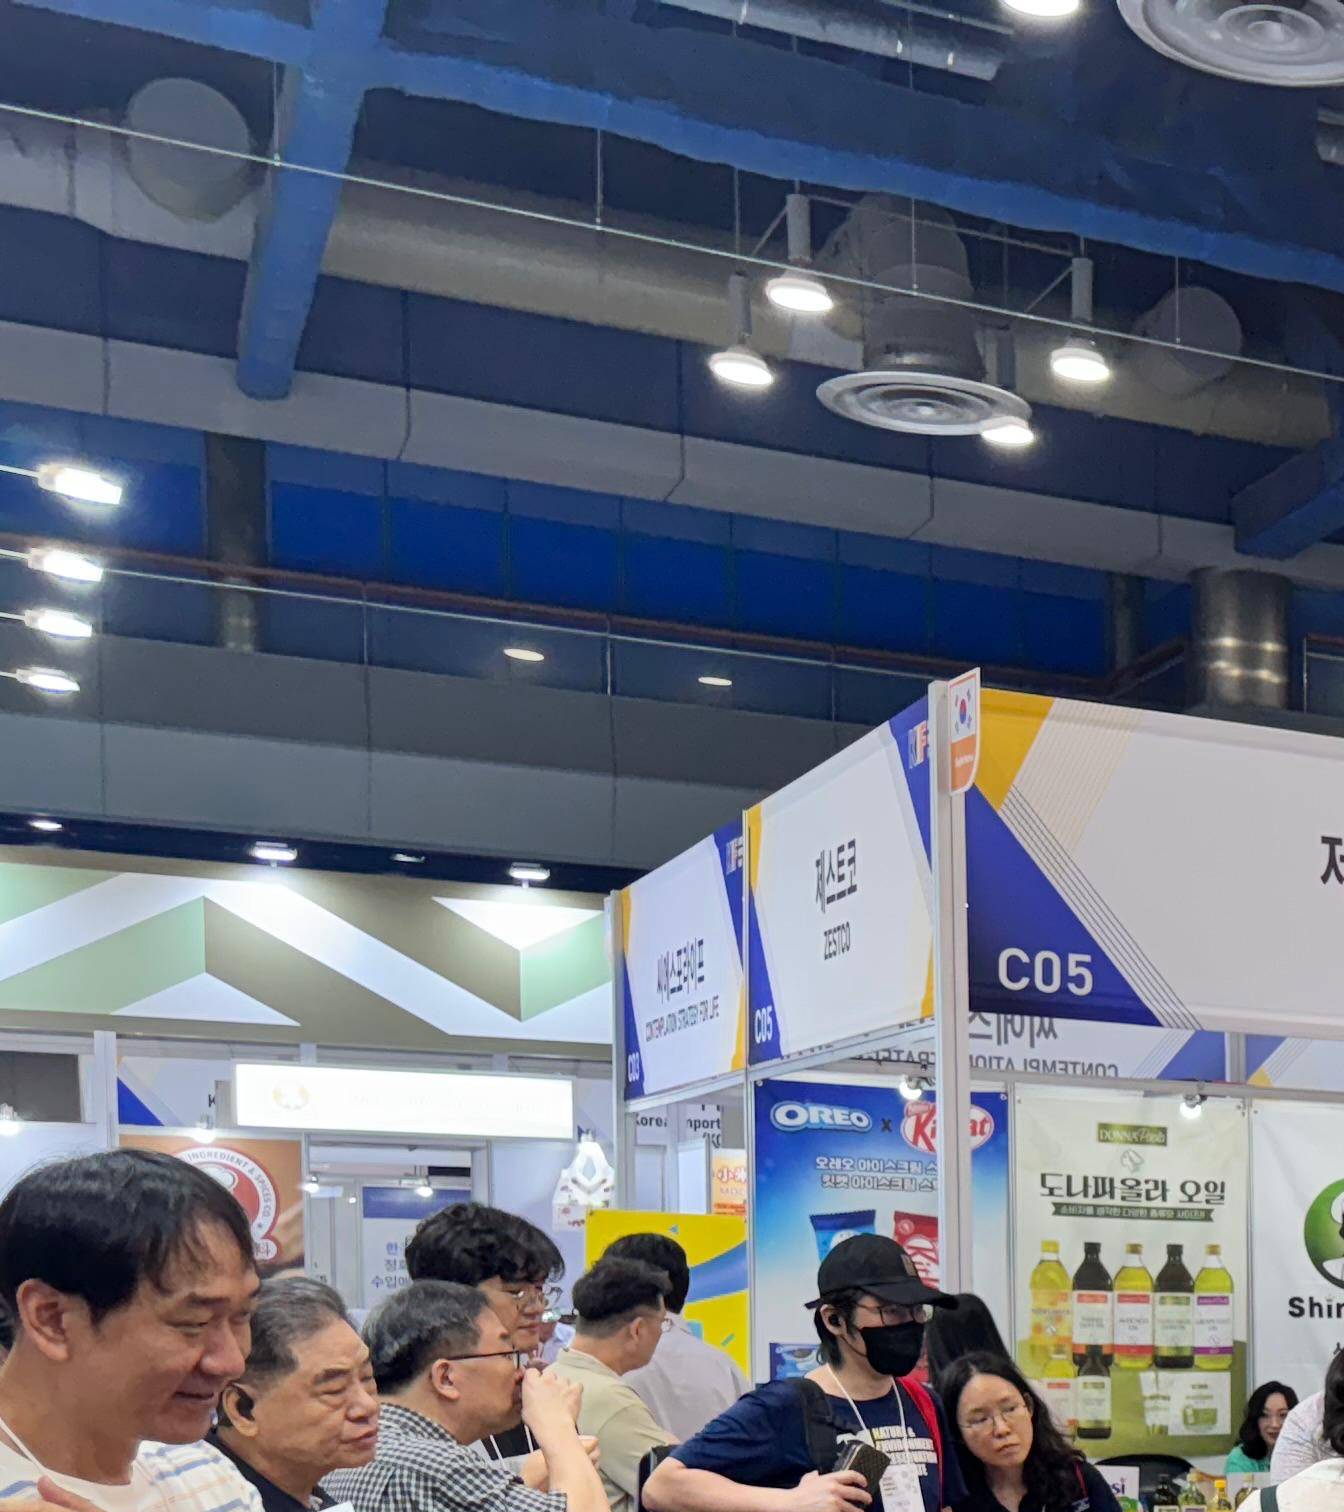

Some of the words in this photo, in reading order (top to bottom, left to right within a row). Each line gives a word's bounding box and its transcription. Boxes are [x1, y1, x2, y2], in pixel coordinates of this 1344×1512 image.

[816, 838, 857, 914] 제스트코
[824, 921, 851, 960] ZESTCO
[997, 947, 1093, 997] C05
[755, 1005, 773, 1044] C05
[775, 1103, 870, 1129] OREO
[816, 1155, 855, 1171] 오레오
[858, 1157, 922, 1175] 아이스크림
[852, 1175, 916, 1191] 아이스크림
[1040, 1172, 1170, 1203] 도나파올라
[1179, 1180, 1225, 1205] 오일
